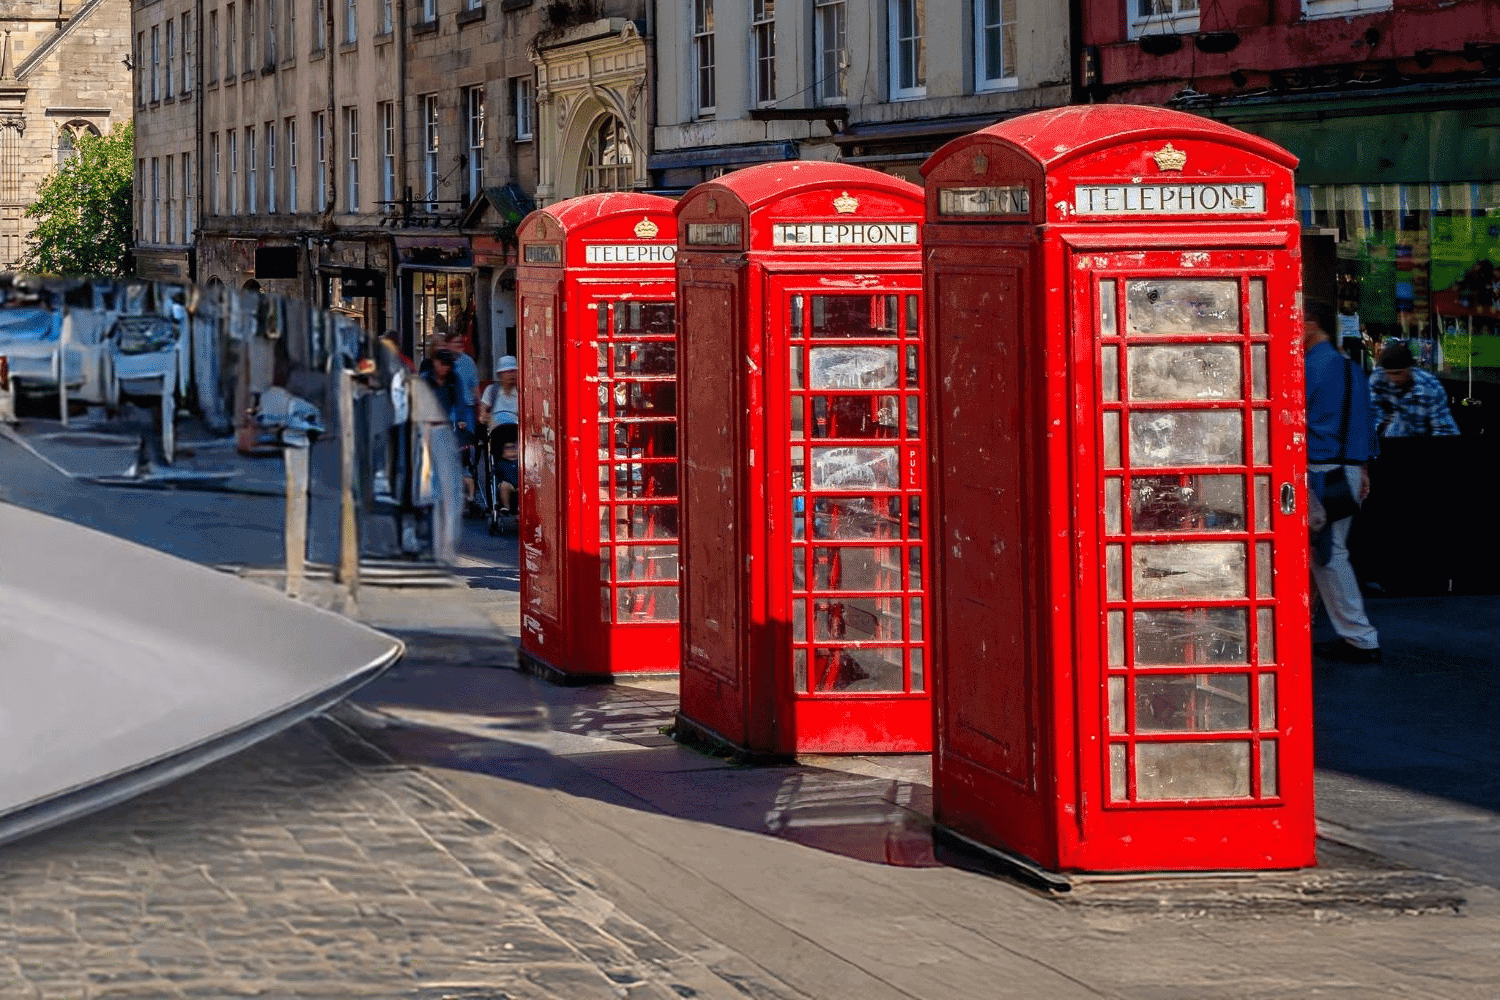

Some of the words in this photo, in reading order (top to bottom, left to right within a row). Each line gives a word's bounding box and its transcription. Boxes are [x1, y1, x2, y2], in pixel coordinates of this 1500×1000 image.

[1083, 186, 1256, 211] TELEPHONE
[778, 224, 911, 244] TELEPHONE
[590, 245, 676, 262] TELEPHO
